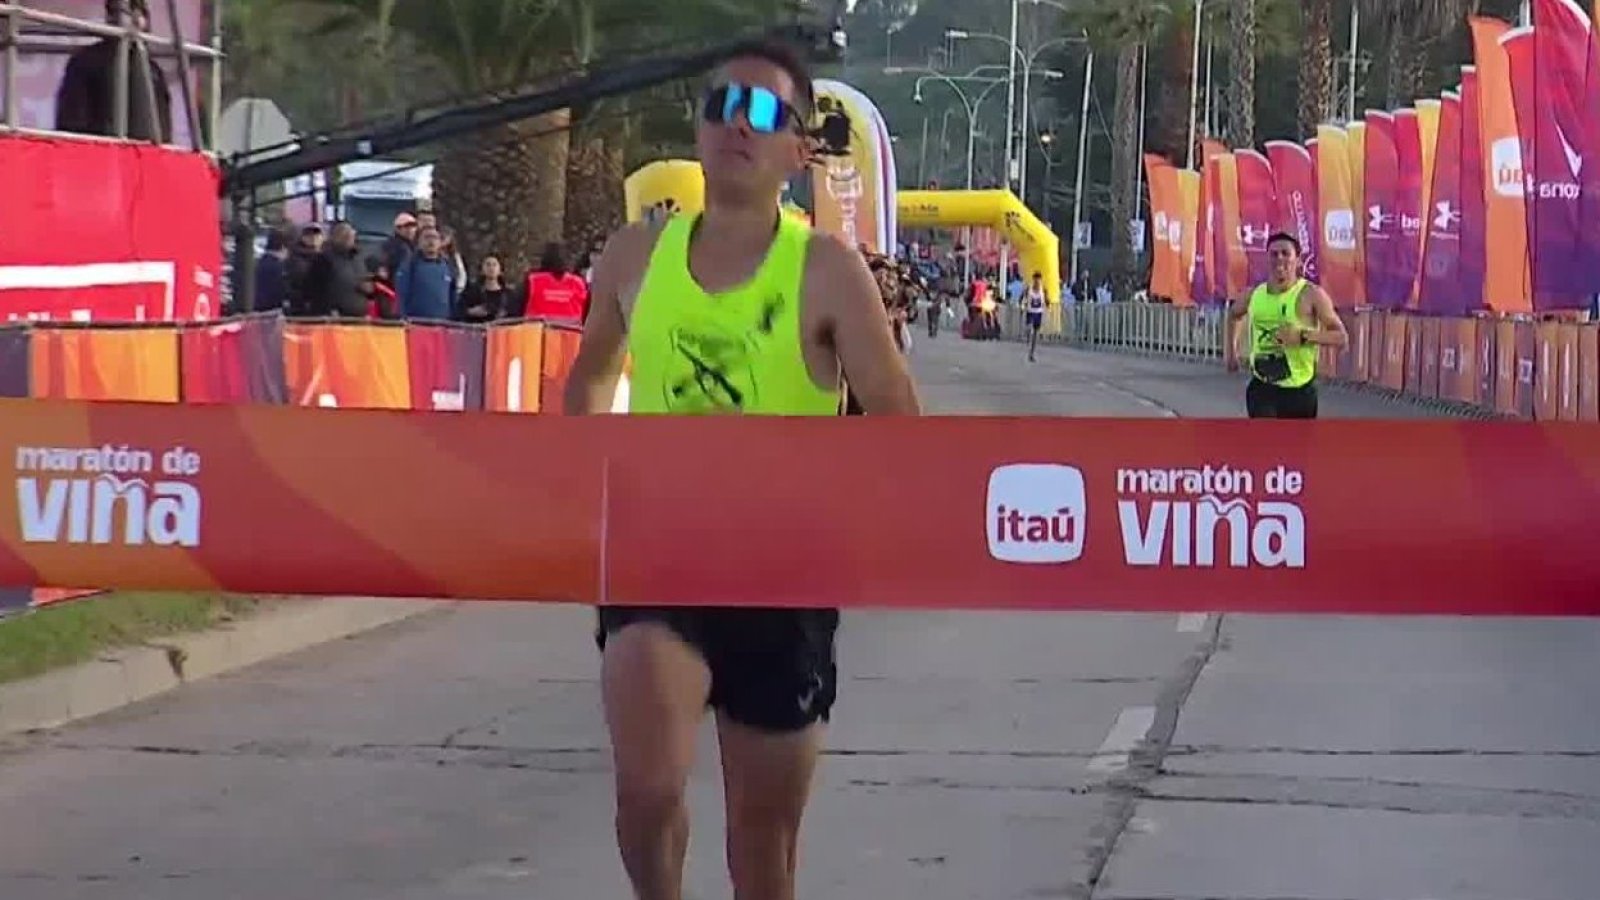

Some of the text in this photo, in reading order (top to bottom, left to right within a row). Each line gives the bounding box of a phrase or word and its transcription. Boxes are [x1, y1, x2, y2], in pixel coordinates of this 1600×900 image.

[16, 444, 200, 475] maratón de
[1117, 463, 1303, 494] maratón de
[996, 504, 1075, 543] itaú
